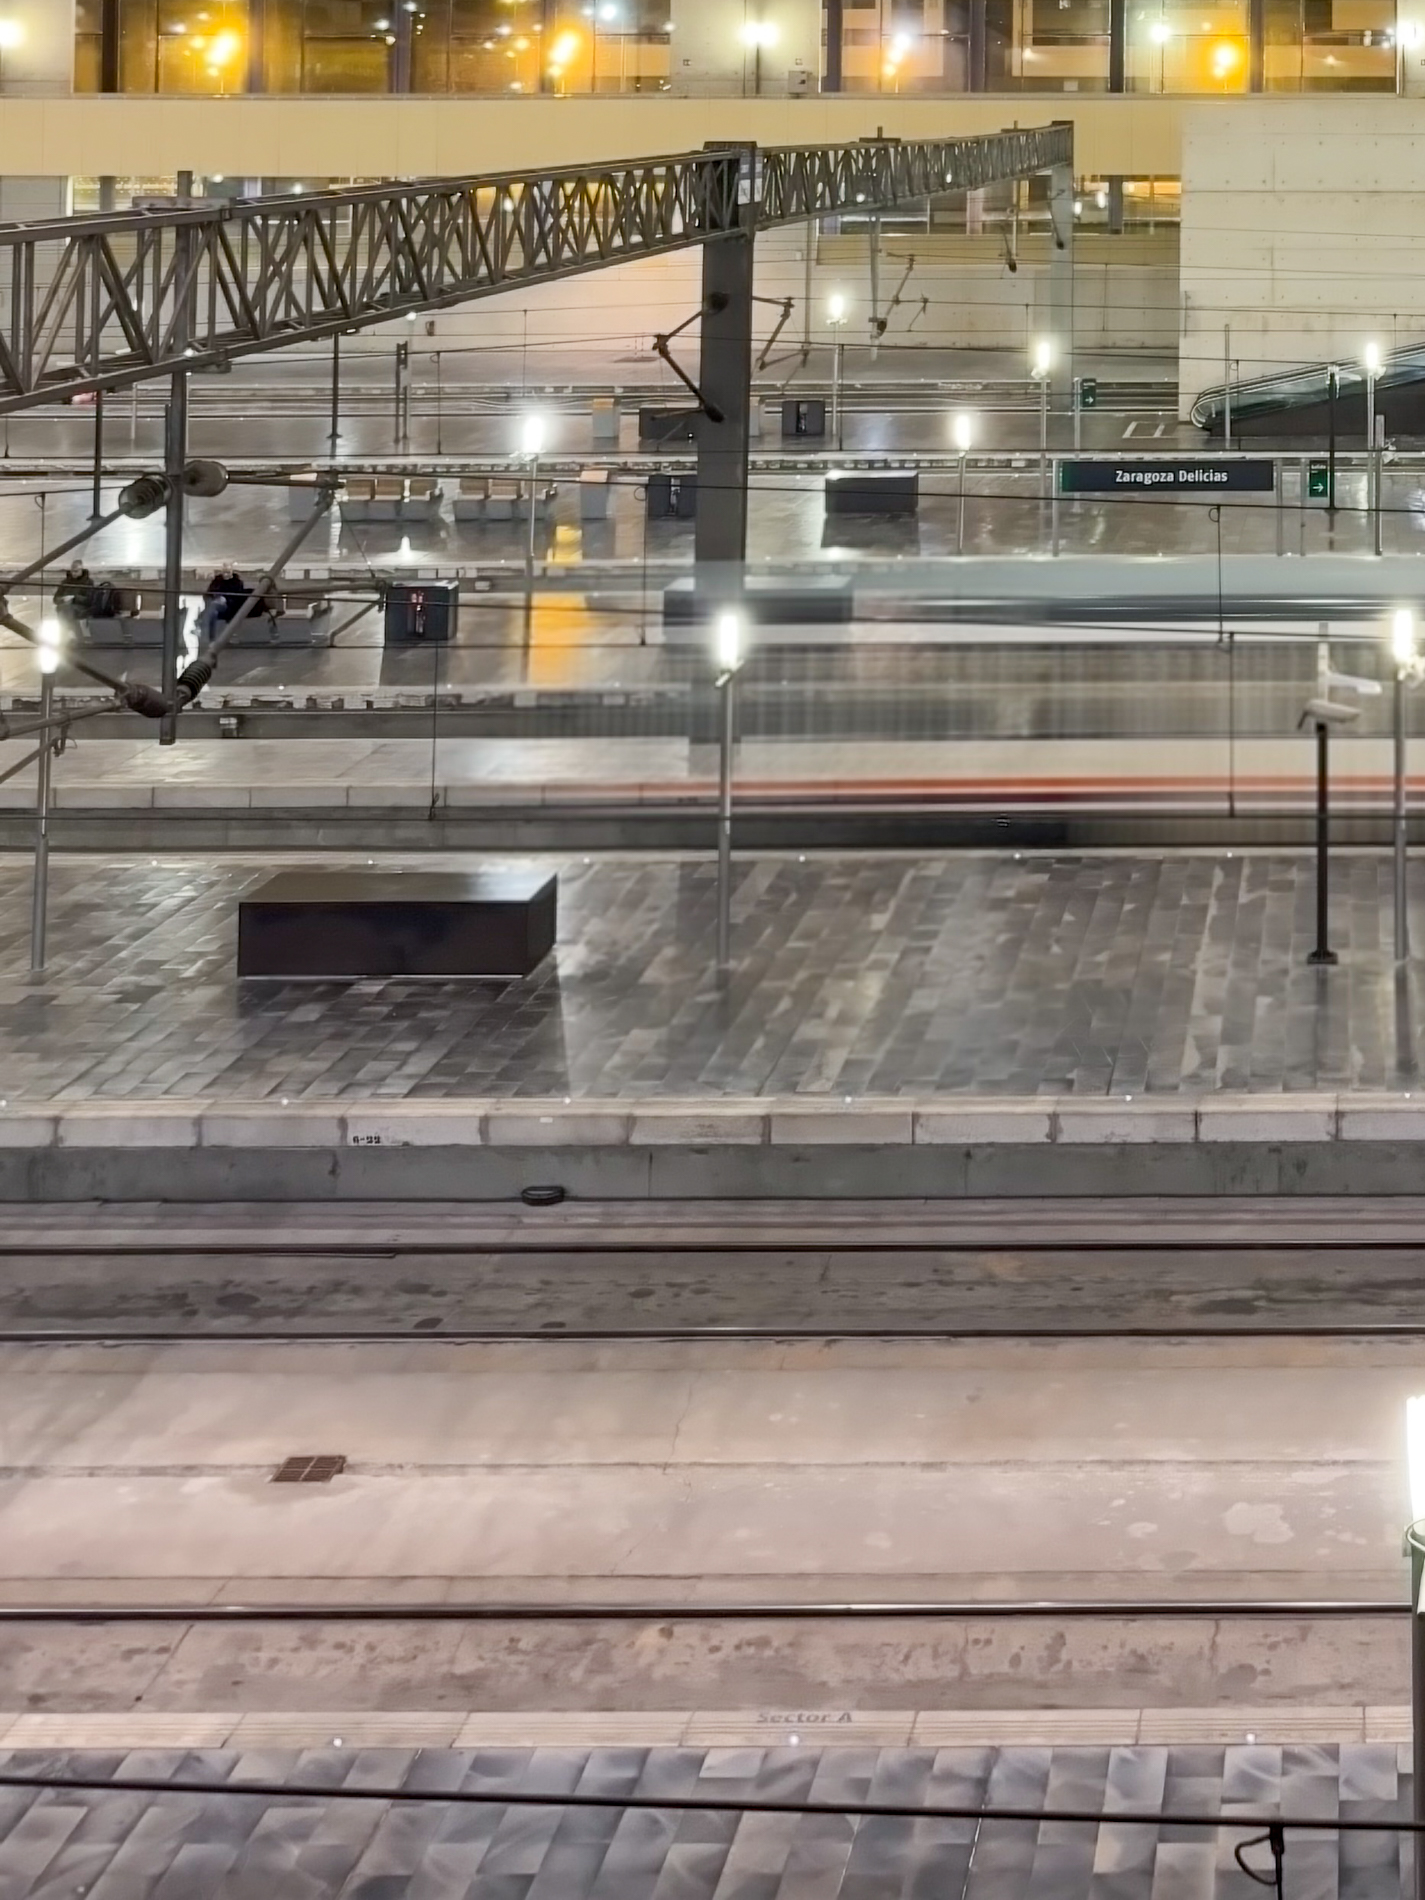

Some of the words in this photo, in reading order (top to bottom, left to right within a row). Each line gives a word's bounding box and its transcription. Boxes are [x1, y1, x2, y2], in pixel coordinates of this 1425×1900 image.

[1115, 470, 1175, 485] Zaragoza
[1178, 469, 1228, 482] Delicias
[757, 1712, 831, 1723] Sector
[836, 1712, 853, 1722] A
